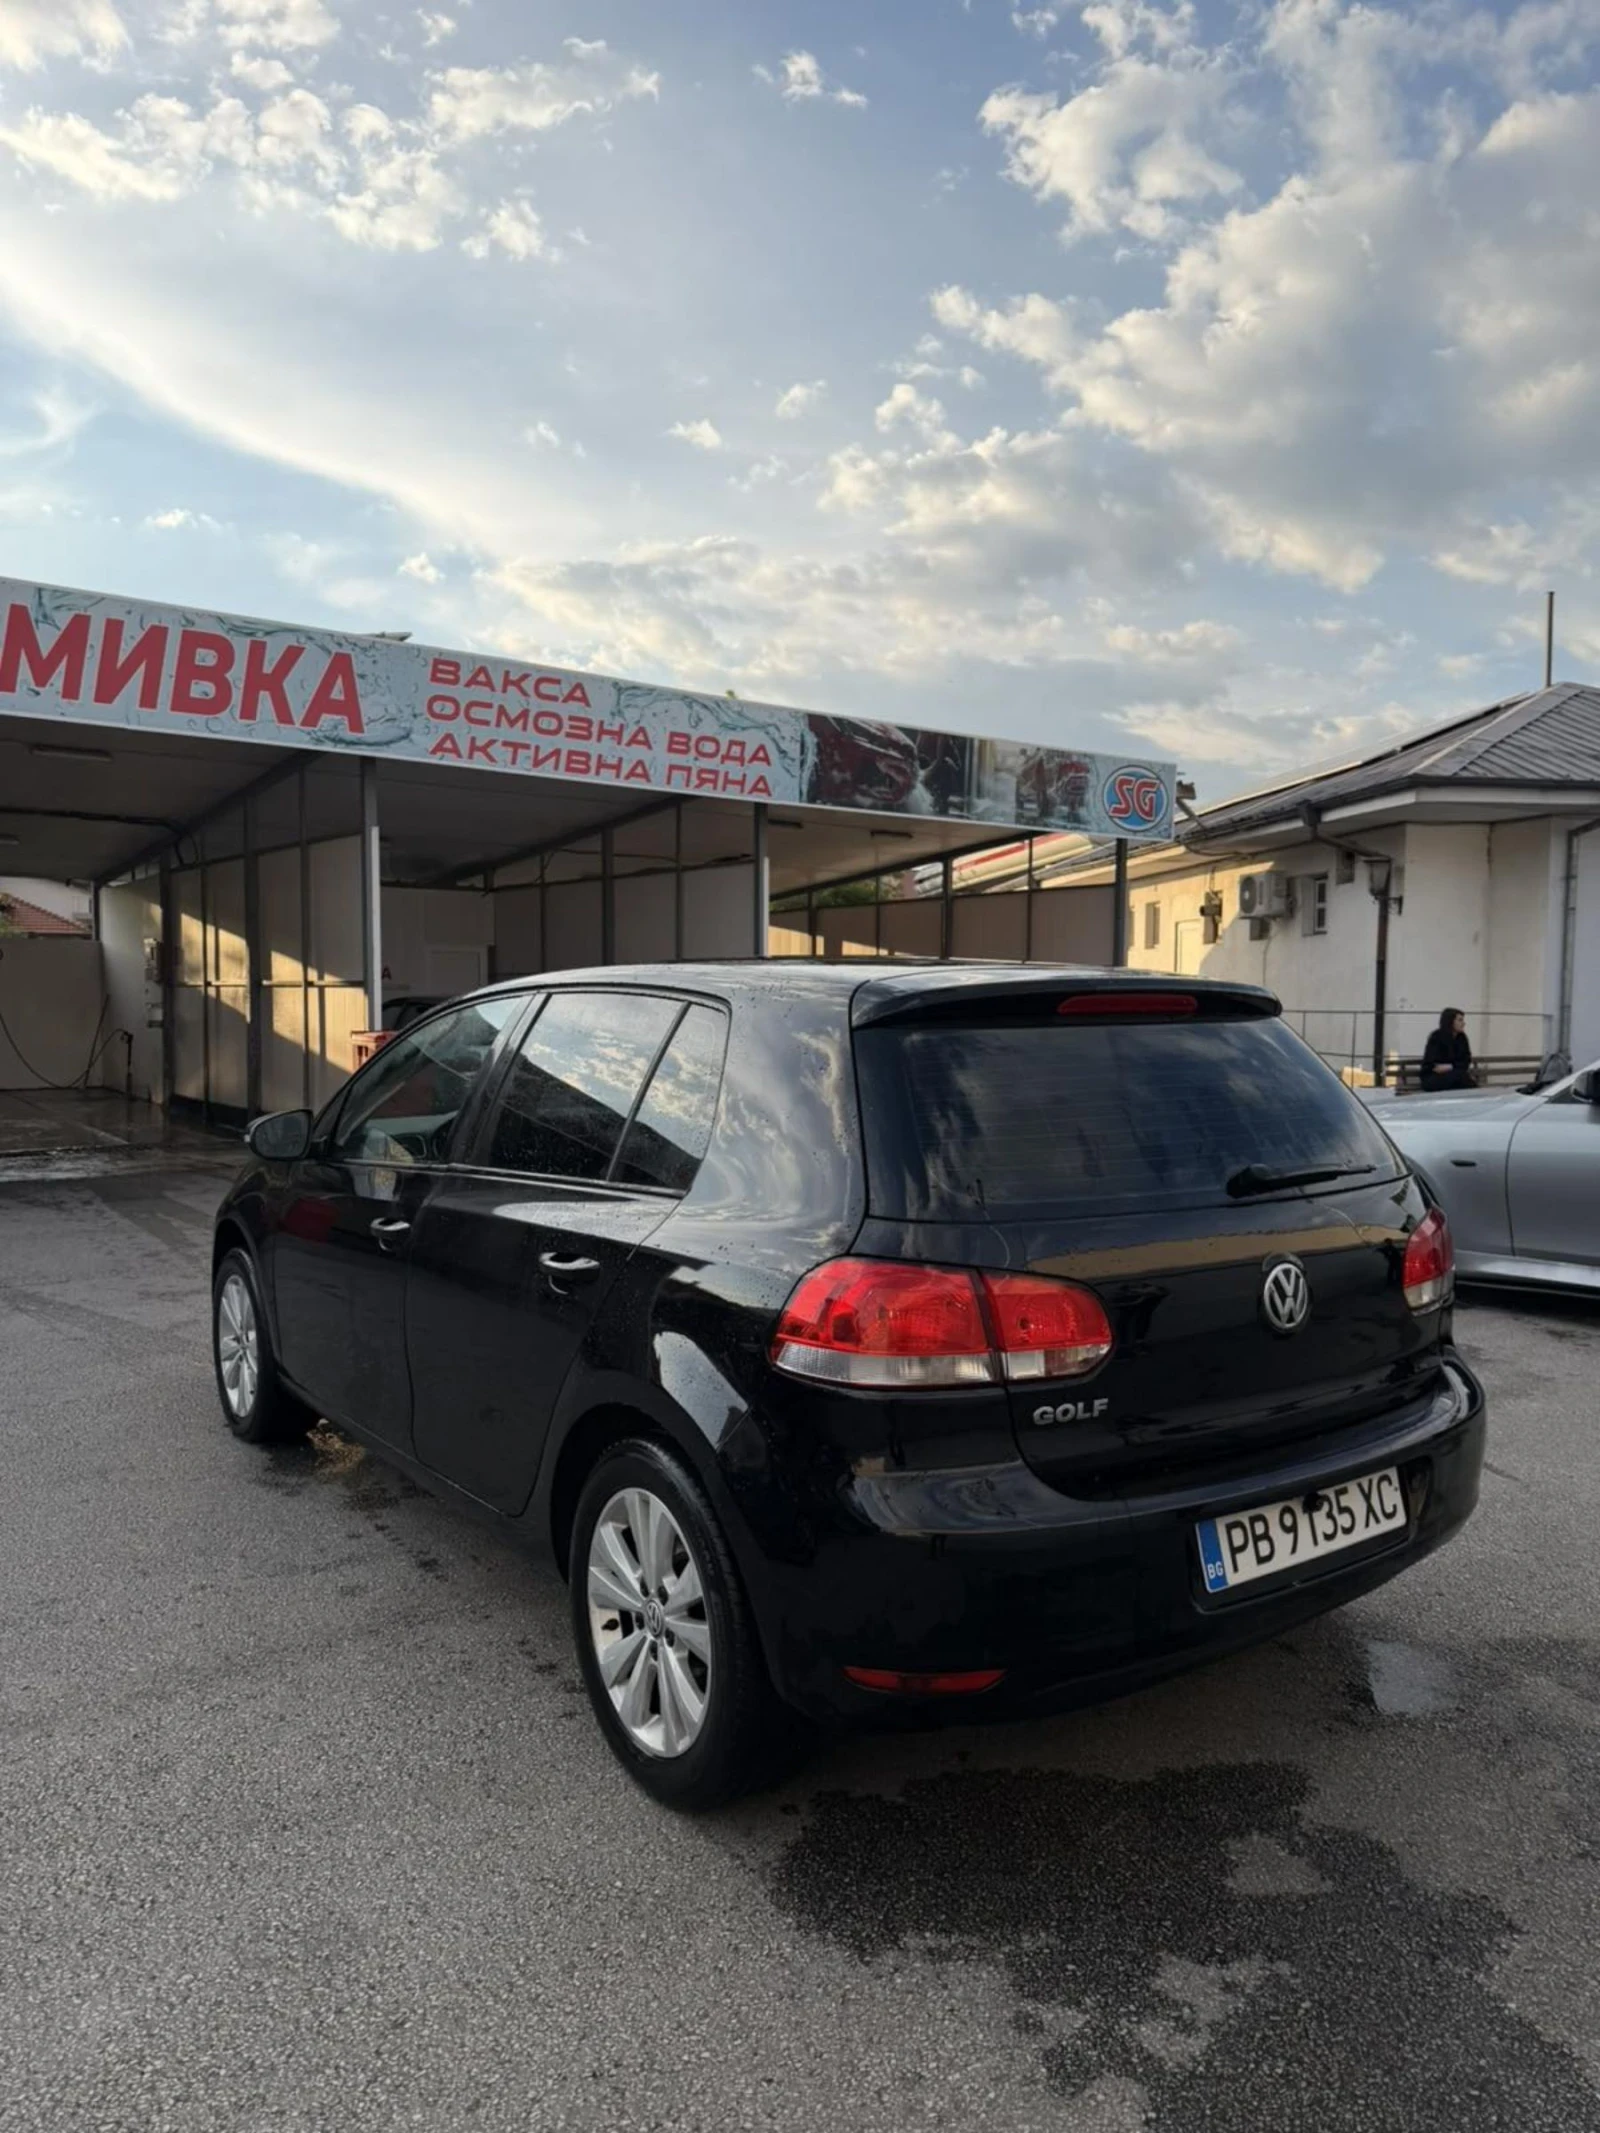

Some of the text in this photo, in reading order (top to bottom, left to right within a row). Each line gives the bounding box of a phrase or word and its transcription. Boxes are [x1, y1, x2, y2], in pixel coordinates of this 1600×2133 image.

[428, 656, 592, 708] ВАКСА
[426, 694, 773, 769] ОСМОЗНА ВОДА
[429, 732, 774, 798] АКТИВНА ПЯНА
[1109, 776, 1160, 823] SG
[1032, 1398, 1109, 1426] GOLF
[1207, 1561, 1224, 1579] BG
